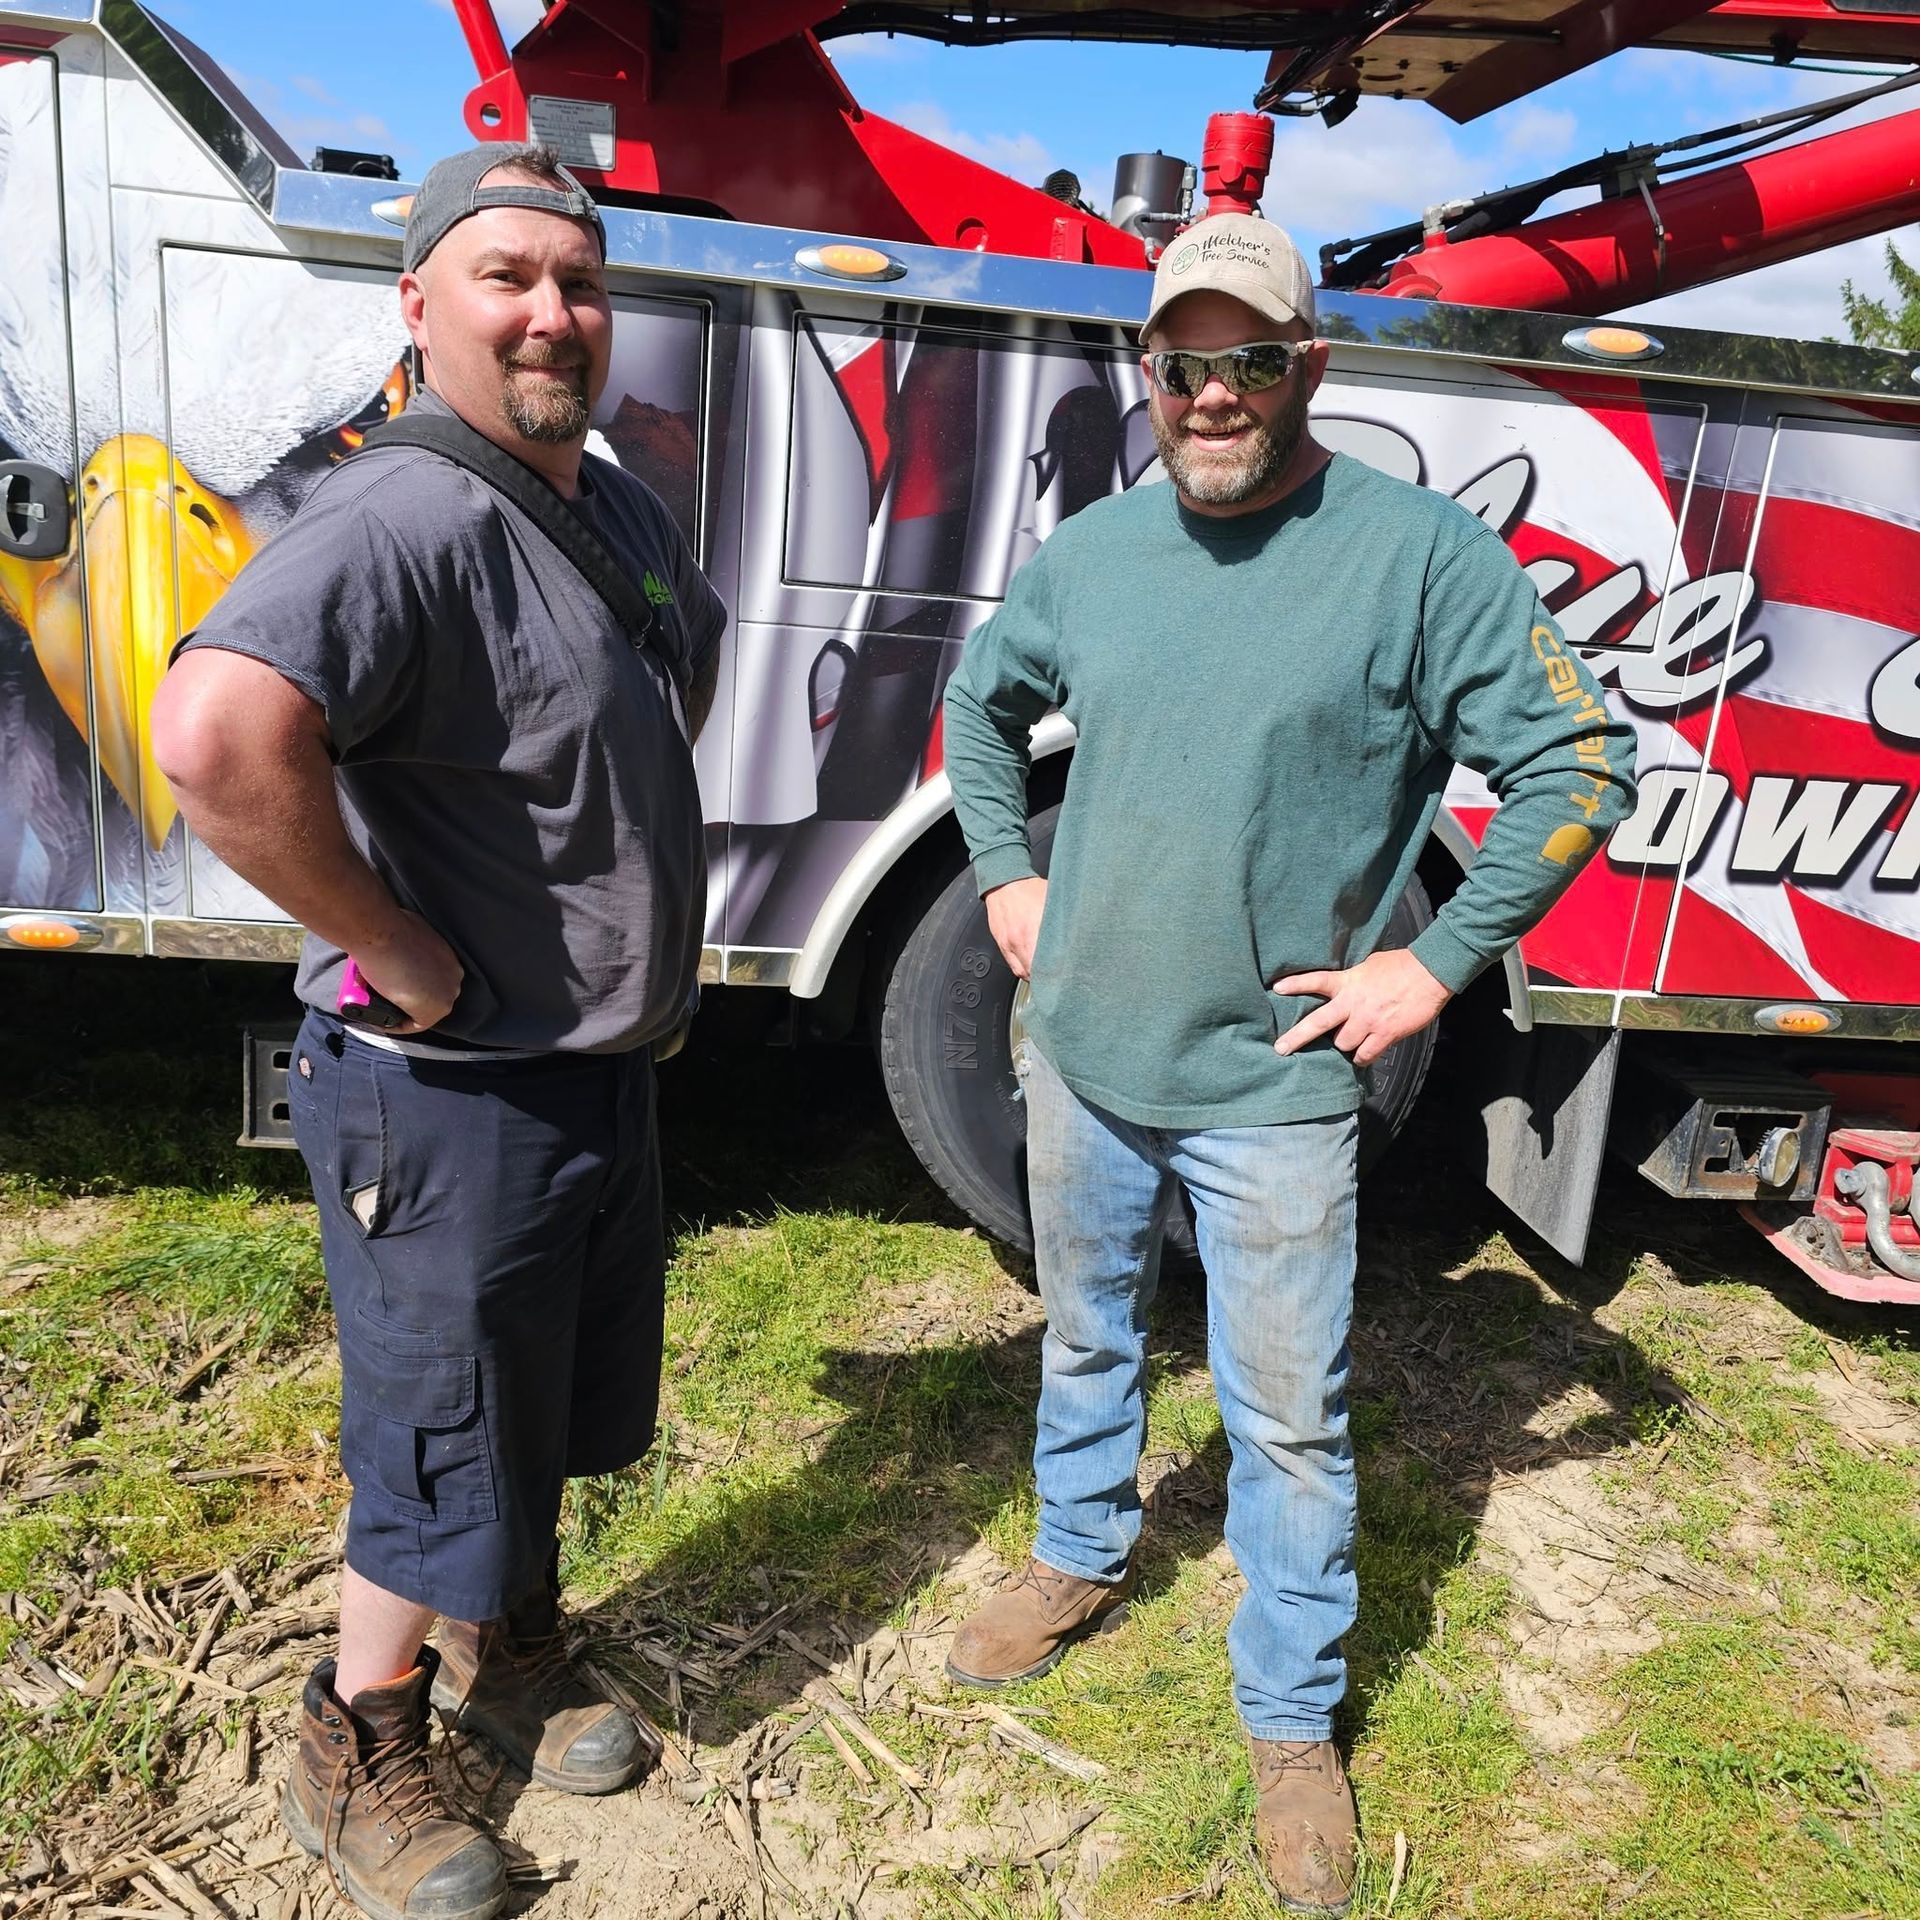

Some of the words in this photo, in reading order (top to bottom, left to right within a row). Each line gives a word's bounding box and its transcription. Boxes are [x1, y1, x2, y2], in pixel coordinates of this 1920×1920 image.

[1202, 233, 1271, 256] Melcher's
[1200, 250, 1222, 263] Tree
[1226, 248, 1270, 269] Service
[944, 946, 992, 1070] N788
